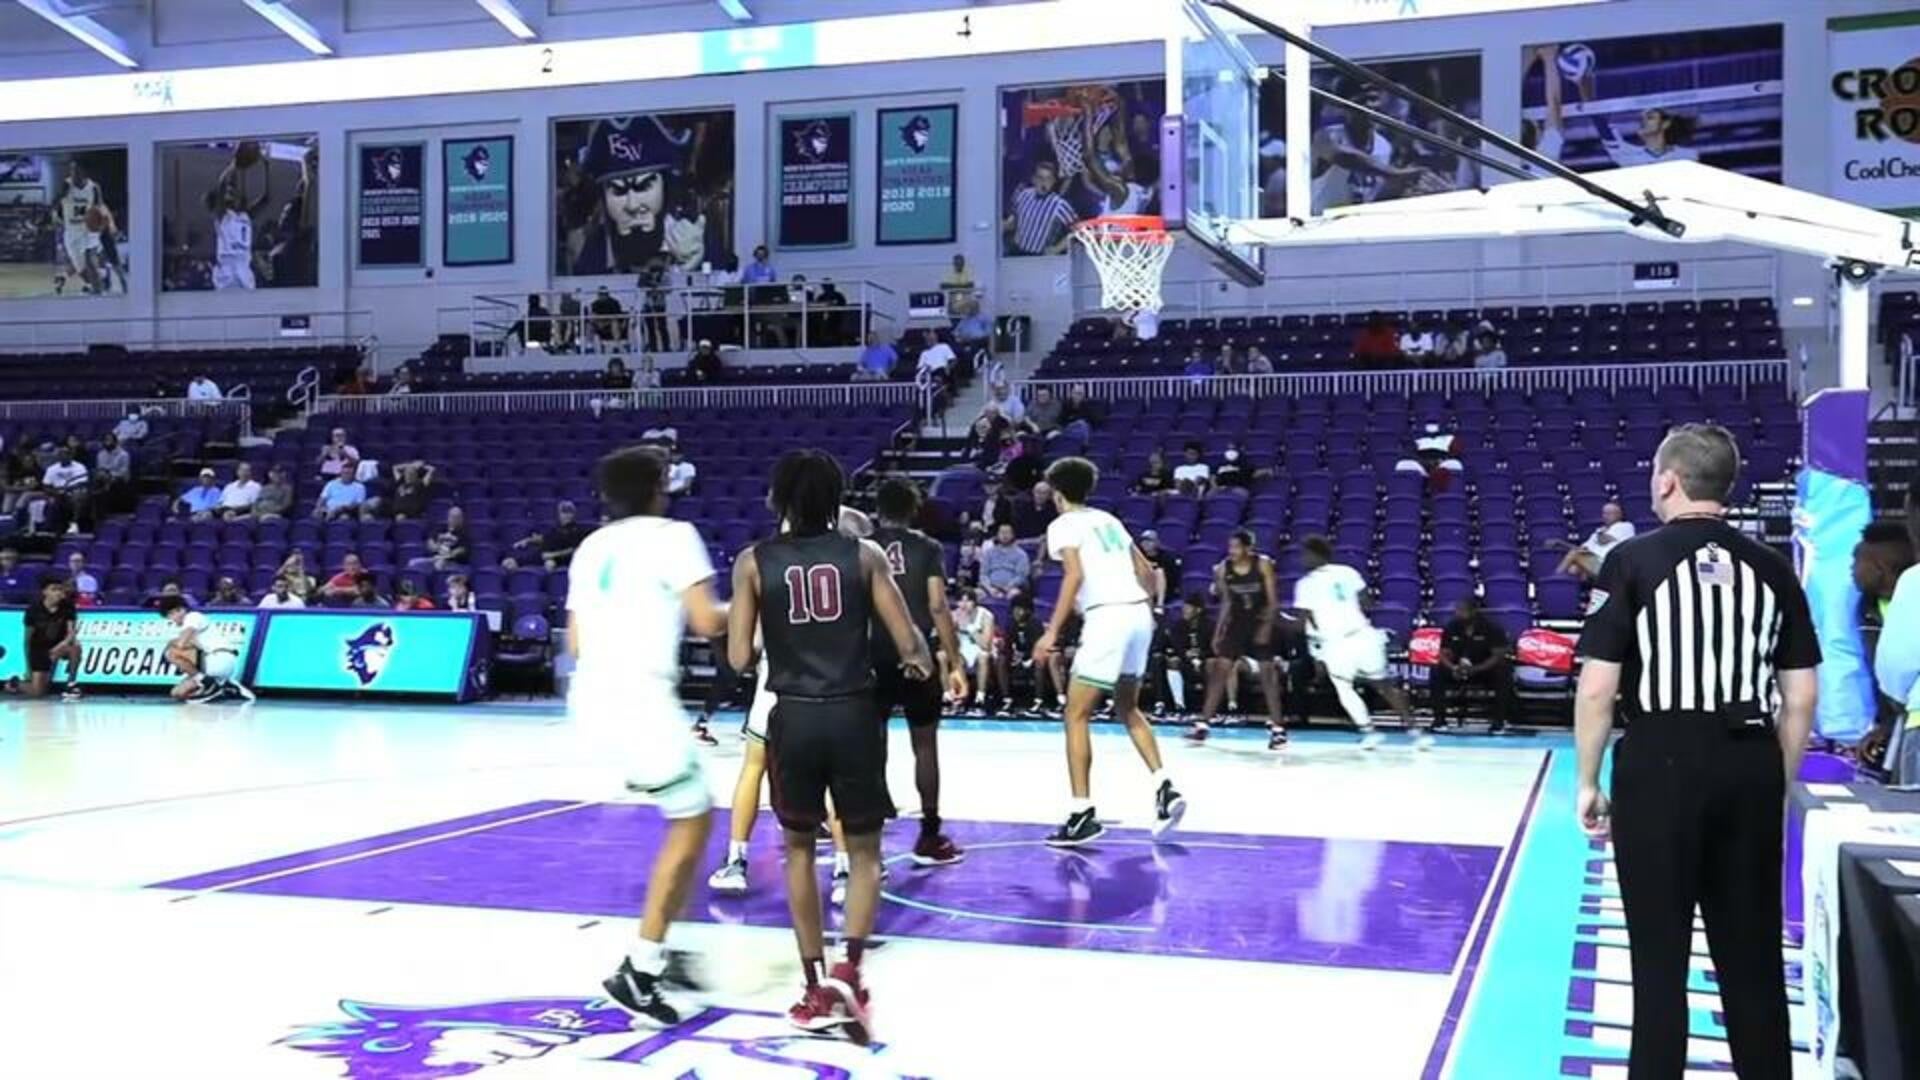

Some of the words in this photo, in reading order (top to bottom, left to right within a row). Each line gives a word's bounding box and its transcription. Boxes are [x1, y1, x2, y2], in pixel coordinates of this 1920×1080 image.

[542, 47, 553, 73] 2
[608, 133, 643, 162] FSW
[784, 563, 842, 624] 10
